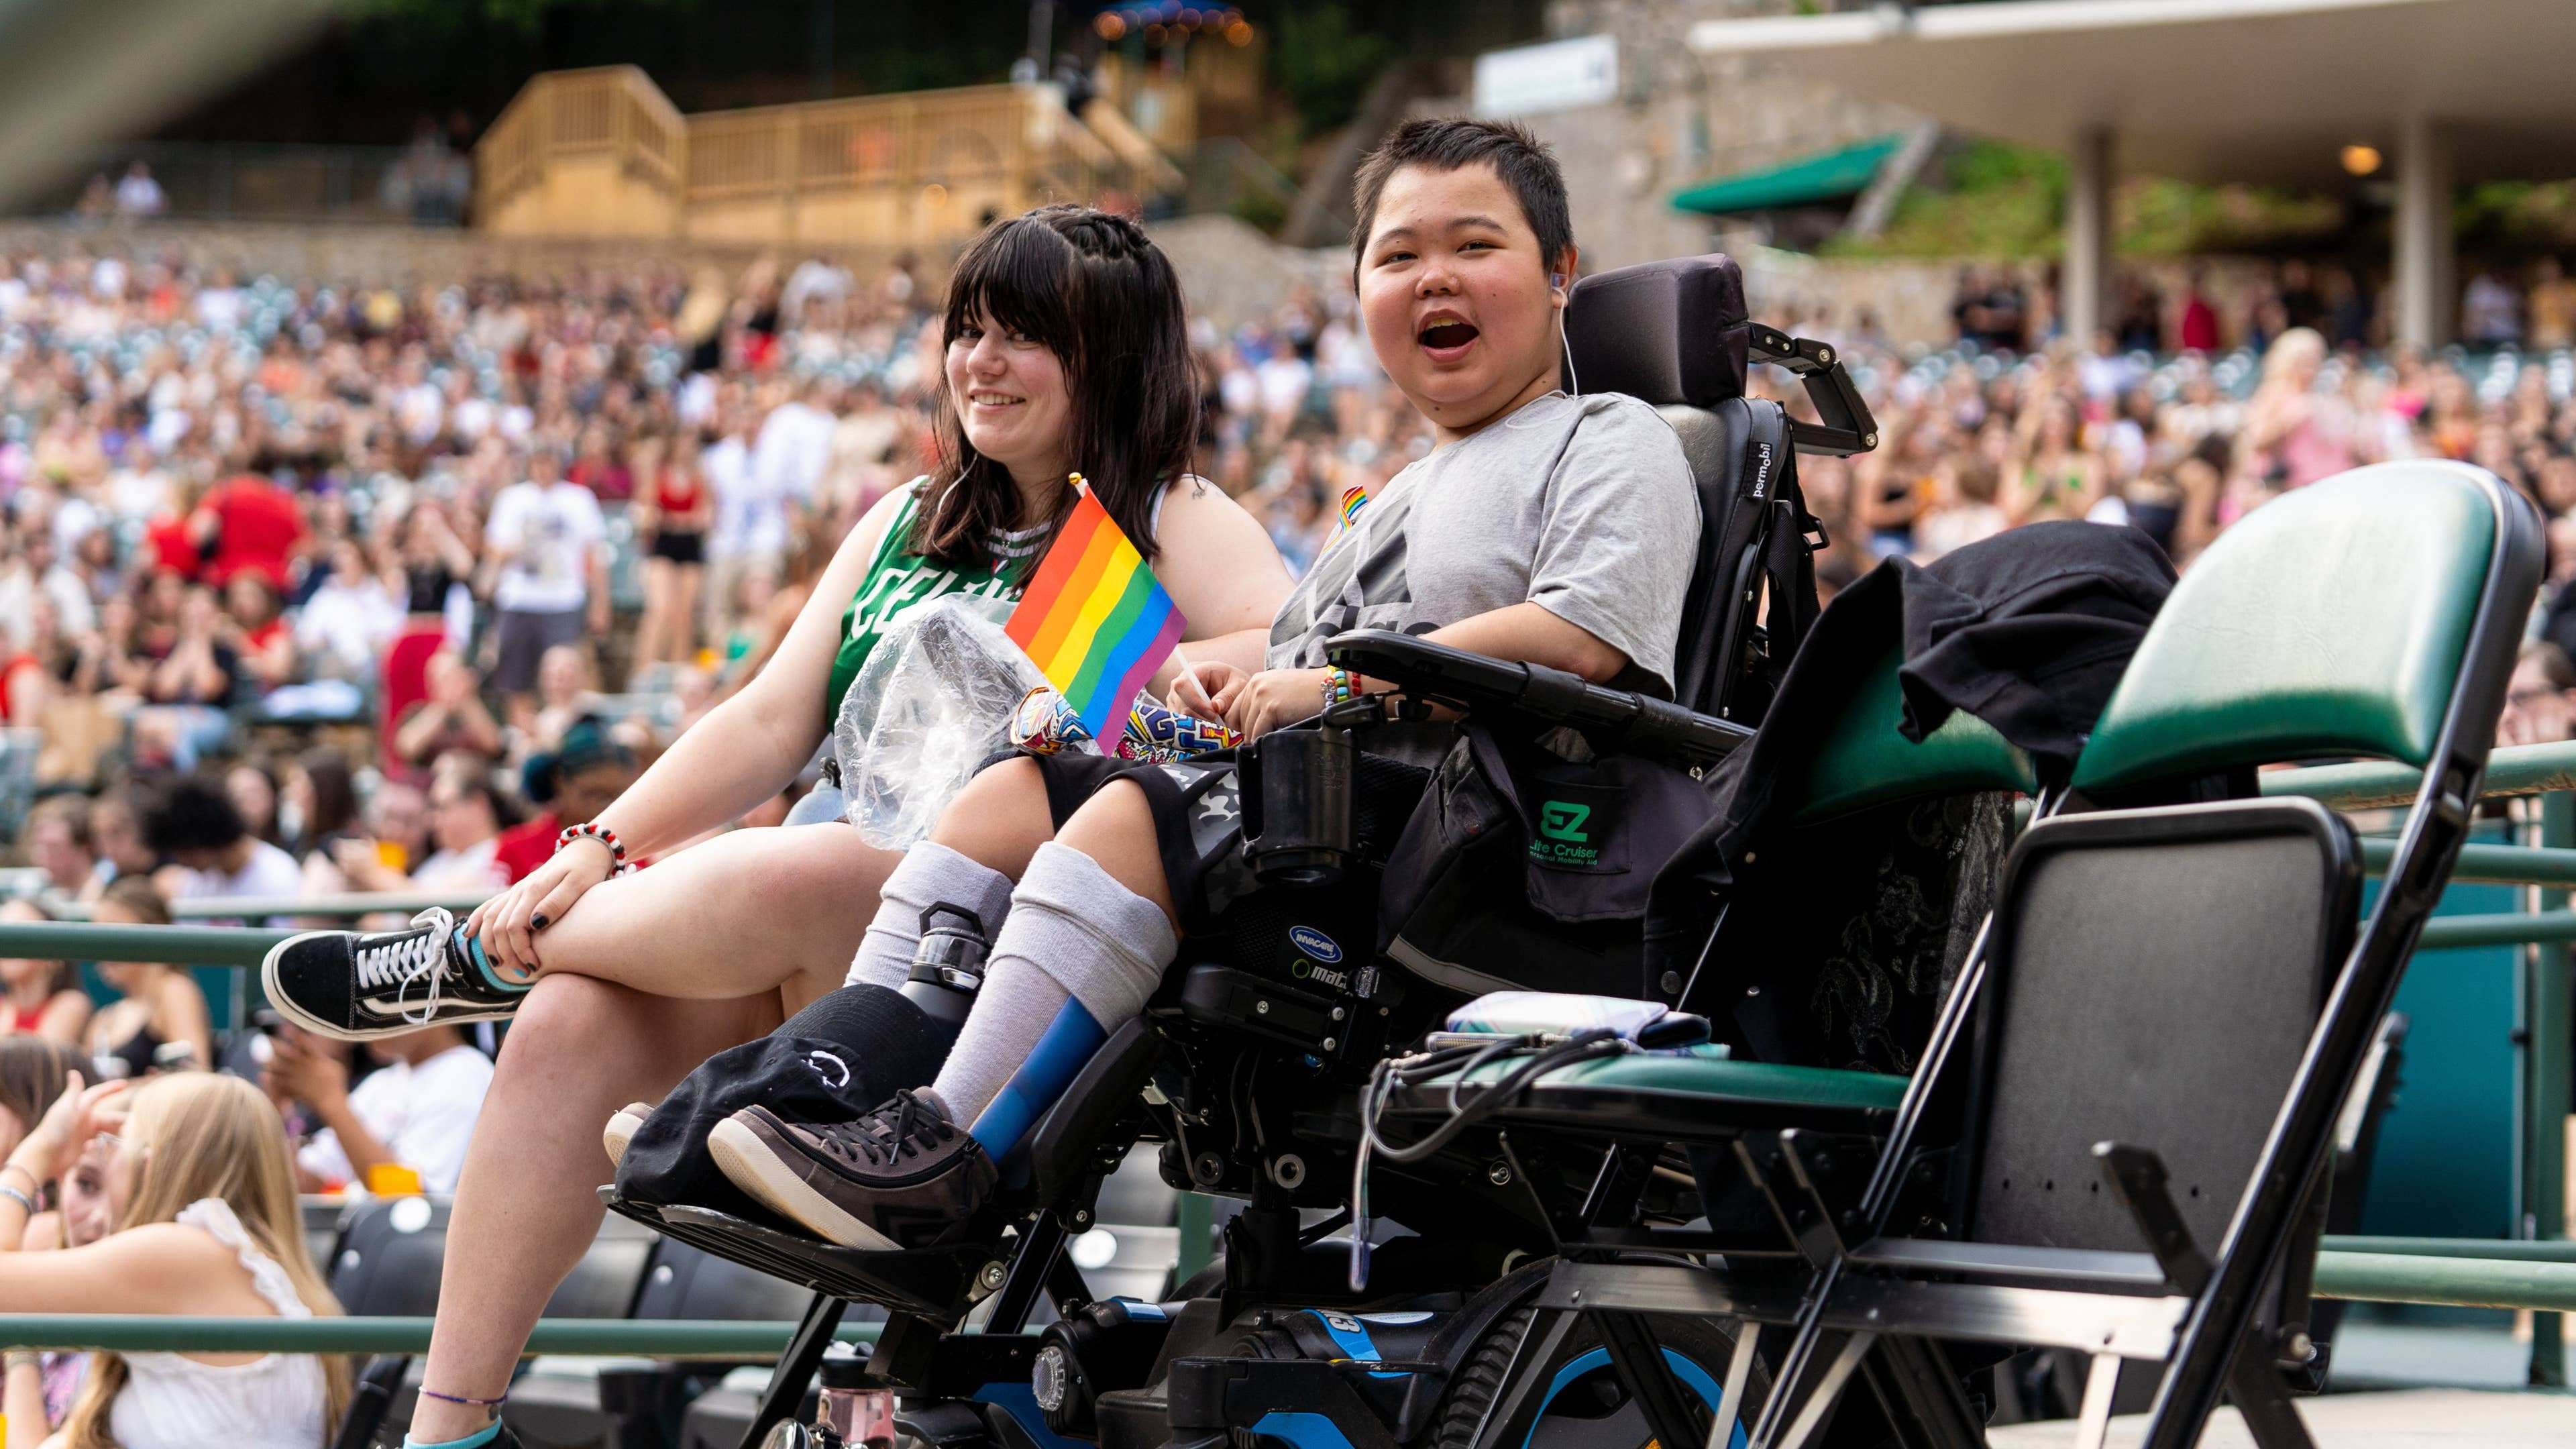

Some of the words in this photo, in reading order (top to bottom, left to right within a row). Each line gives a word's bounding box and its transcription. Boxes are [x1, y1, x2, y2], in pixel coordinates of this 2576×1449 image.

[1752, 443, 1772, 498] permobil
[1541, 800, 1591, 843] EZ
[1529, 851, 1555, 862] ersonal
[1554, 844, 1598, 859] Cruiser
[1296, 933, 1335, 953] INVACARE
